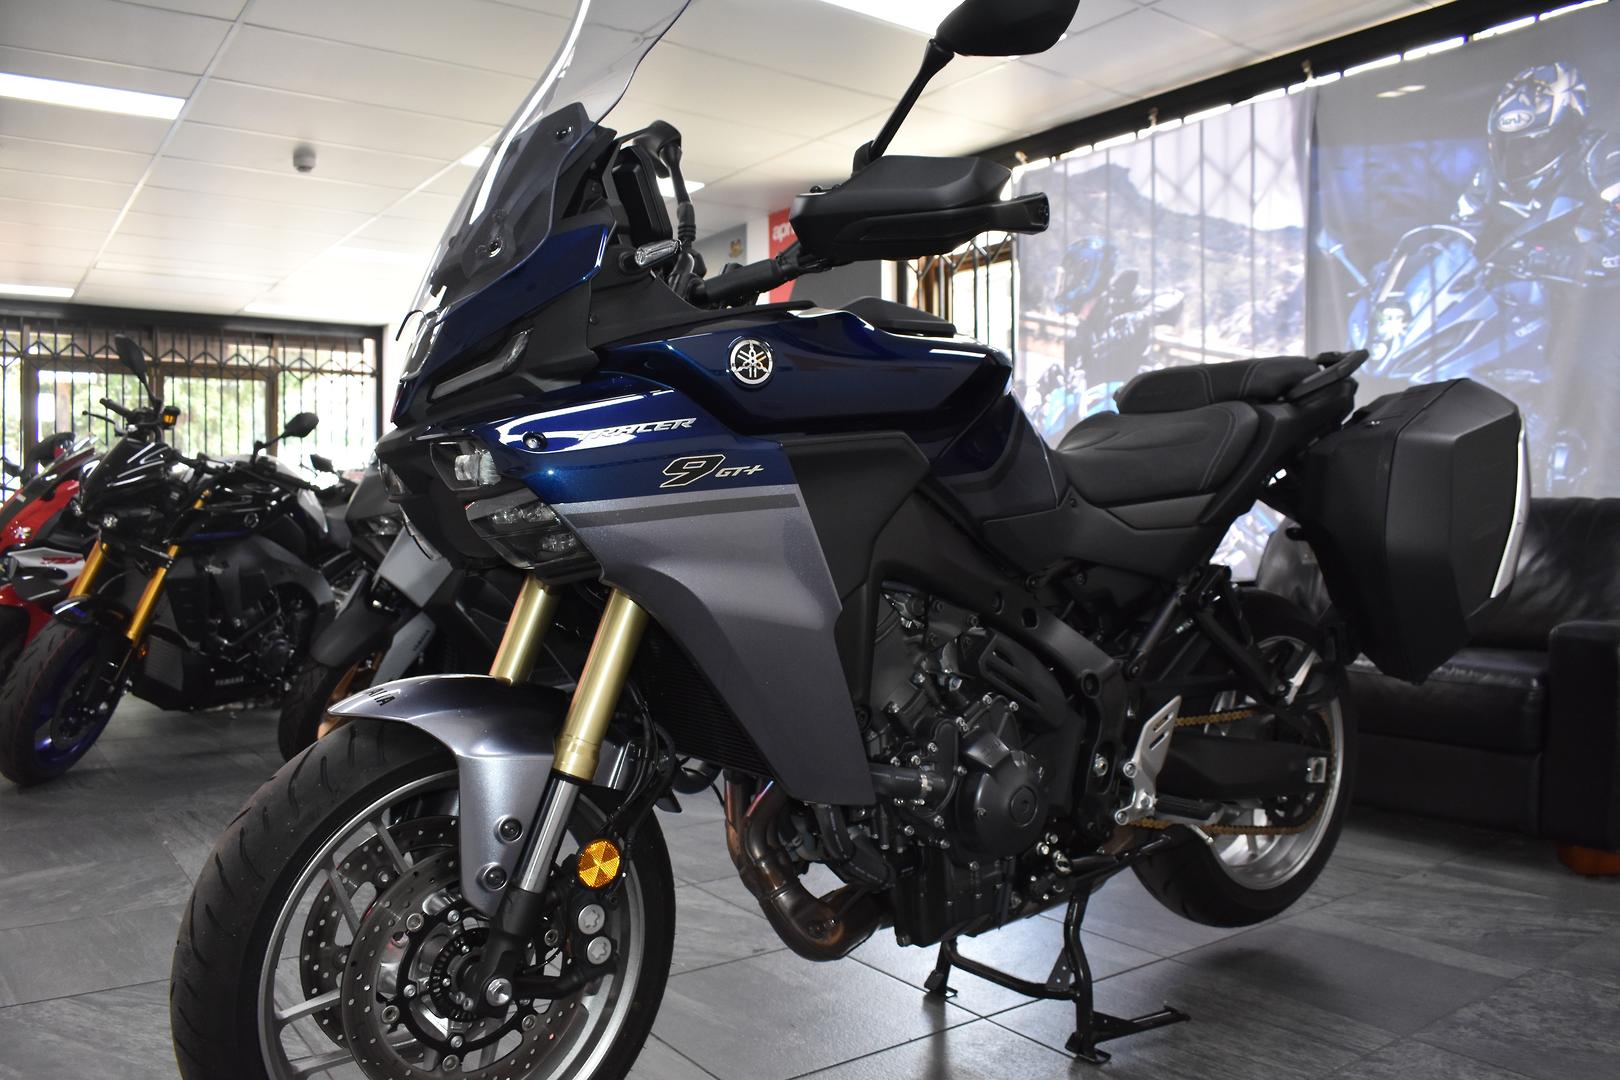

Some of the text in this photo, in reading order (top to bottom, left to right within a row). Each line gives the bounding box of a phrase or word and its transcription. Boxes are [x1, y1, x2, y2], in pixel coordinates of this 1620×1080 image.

[577, 417, 697, 442] TRACER
[659, 454, 764, 488] 9 GT+
